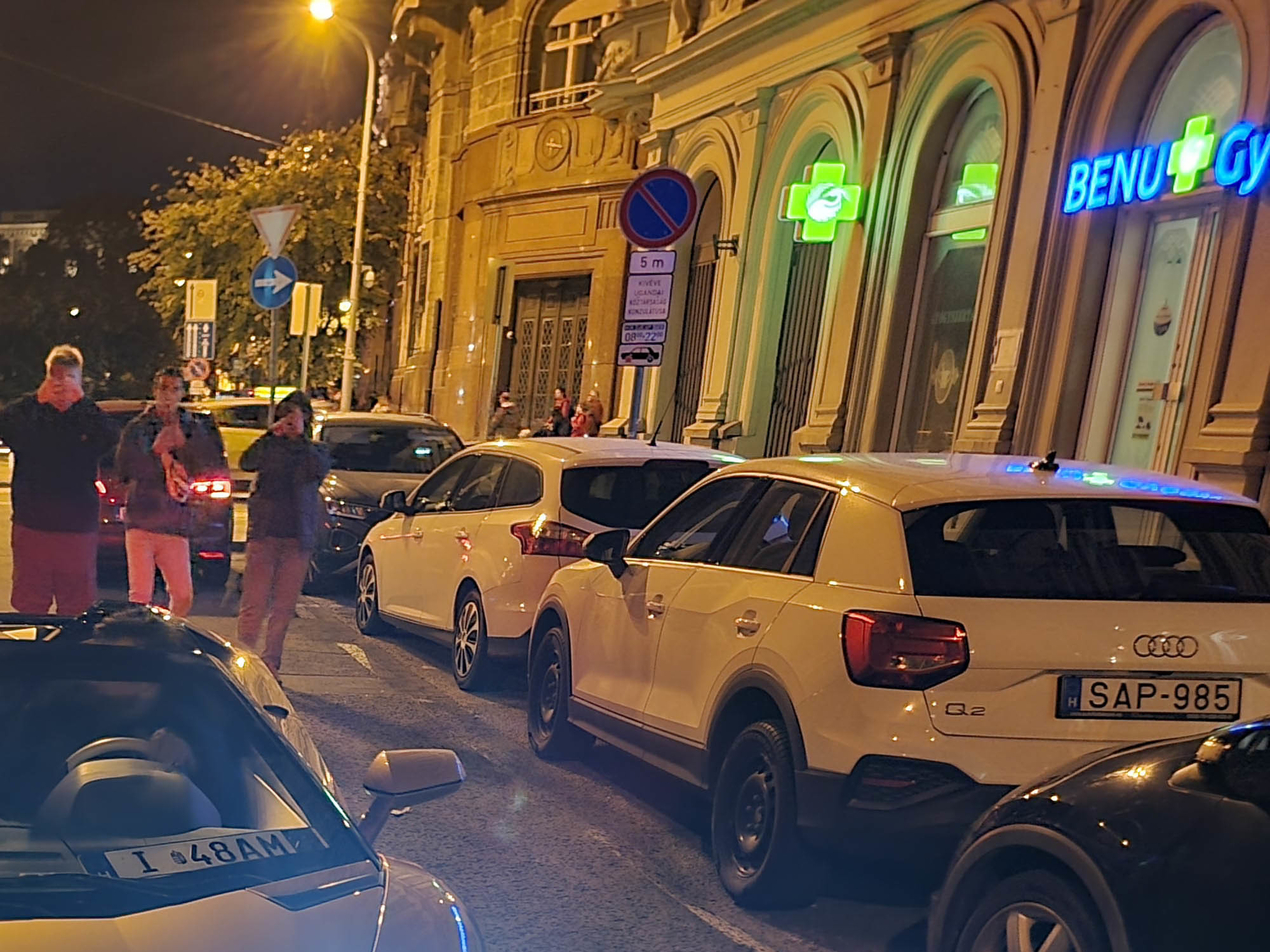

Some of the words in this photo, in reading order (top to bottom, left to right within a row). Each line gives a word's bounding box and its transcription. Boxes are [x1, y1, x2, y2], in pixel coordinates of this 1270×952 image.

[1064, 142, 1172, 214] BENU
[640, 256, 647, 268] 5
[652, 260, 664, 268] m
[1068, 697, 1077, 708] H
[1088, 681, 1230, 711] SAP-985
[945, 703, 986, 717] Q2
[190, 833, 288, 865] 48AM
